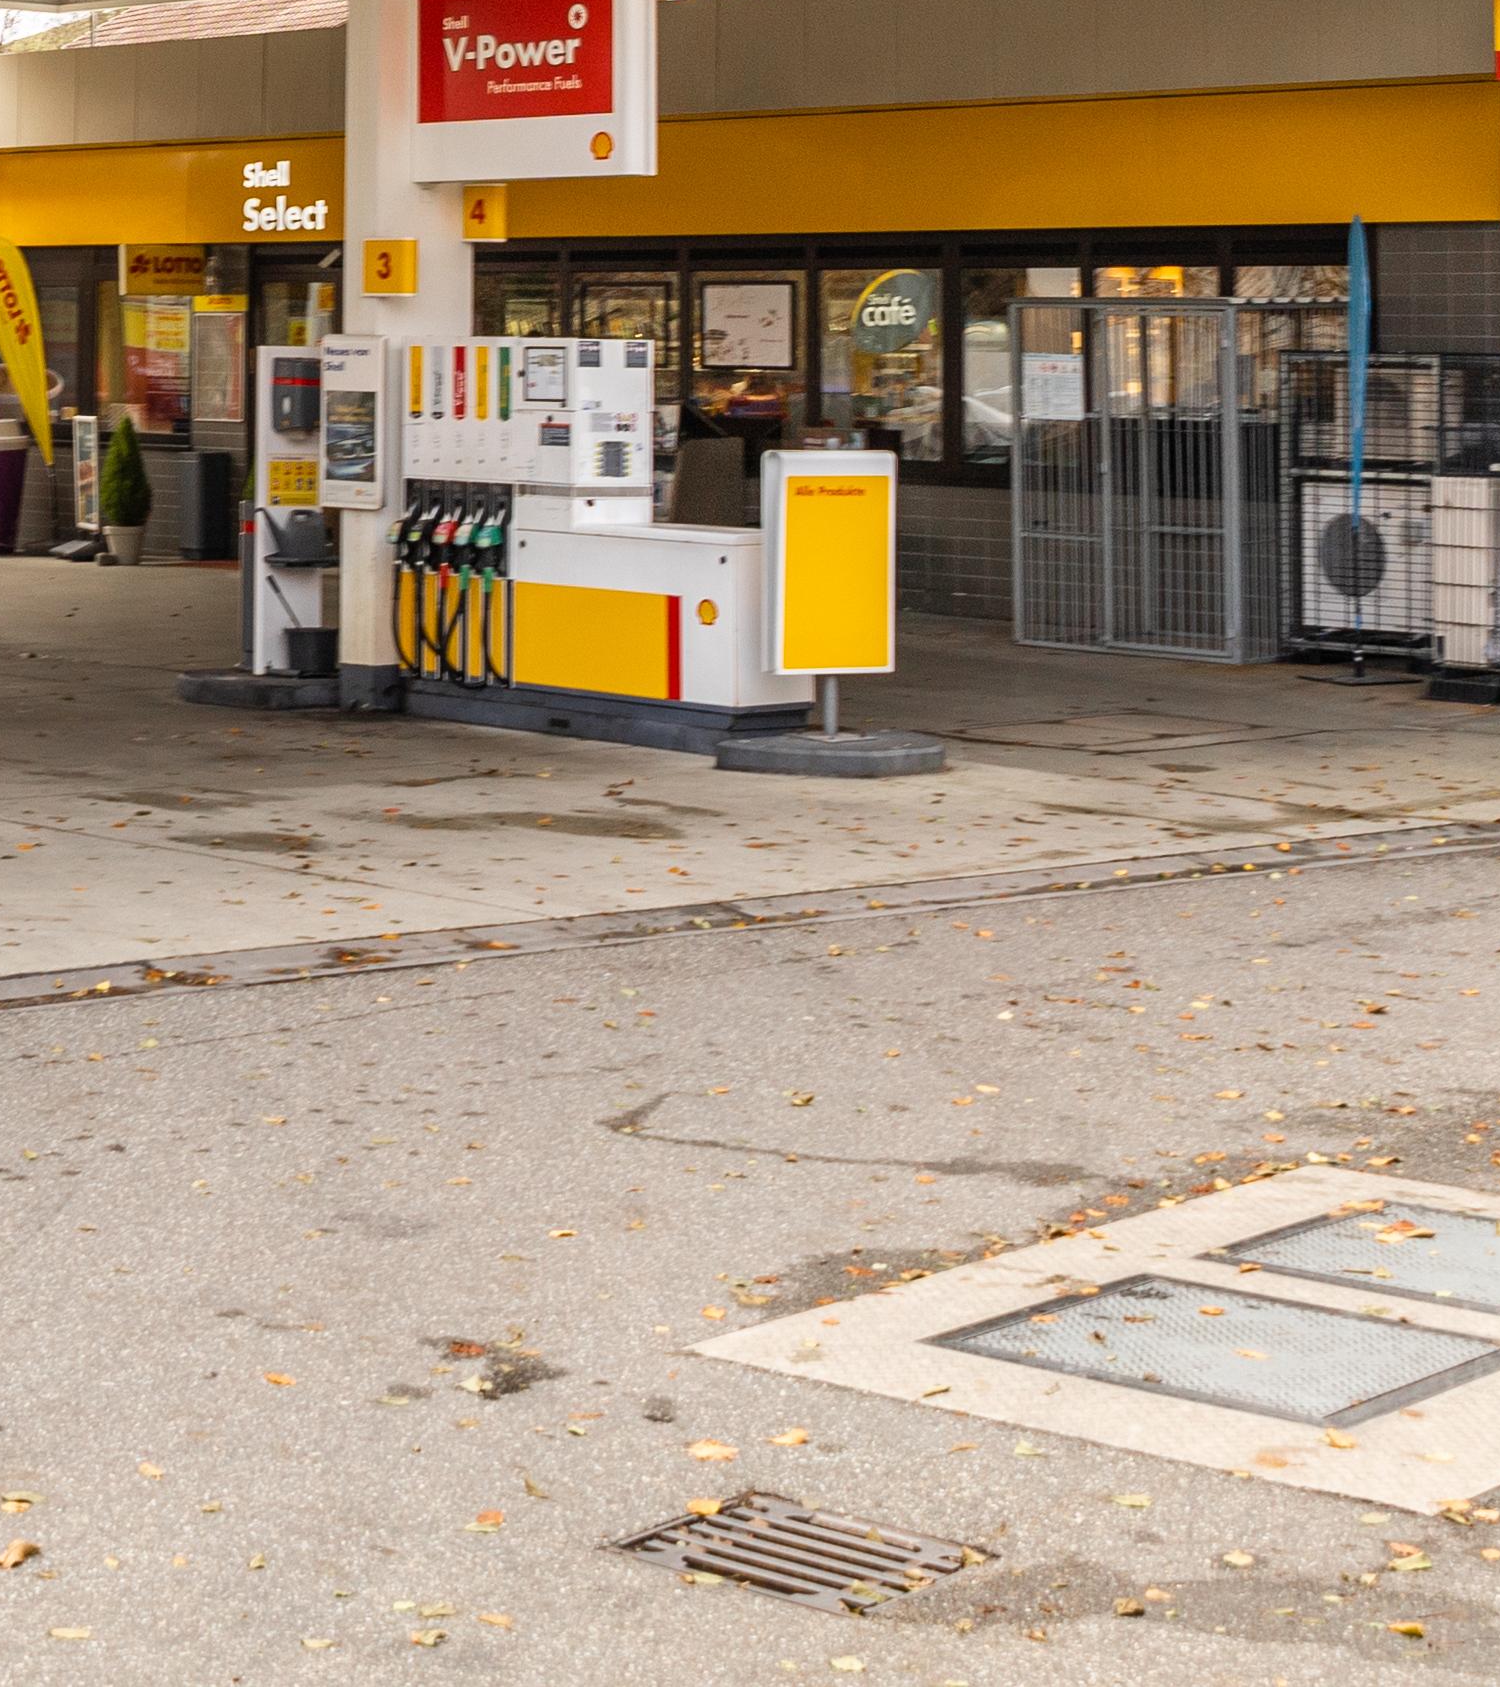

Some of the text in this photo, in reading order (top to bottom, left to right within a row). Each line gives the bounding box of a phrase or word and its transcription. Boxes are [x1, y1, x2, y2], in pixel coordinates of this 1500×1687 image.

[442, 15, 469, 30] Shell
[442, 34, 582, 72] V-Power
[487, 74, 583, 94] Performance Fuels
[243, 160, 290, 188] Shell
[242, 195, 328, 231] Select
[469, 199, 487, 225] 4
[153, 256, 206, 273] LOTTO
[376, 252, 392, 279] 3
[861, 296, 917, 327] café
